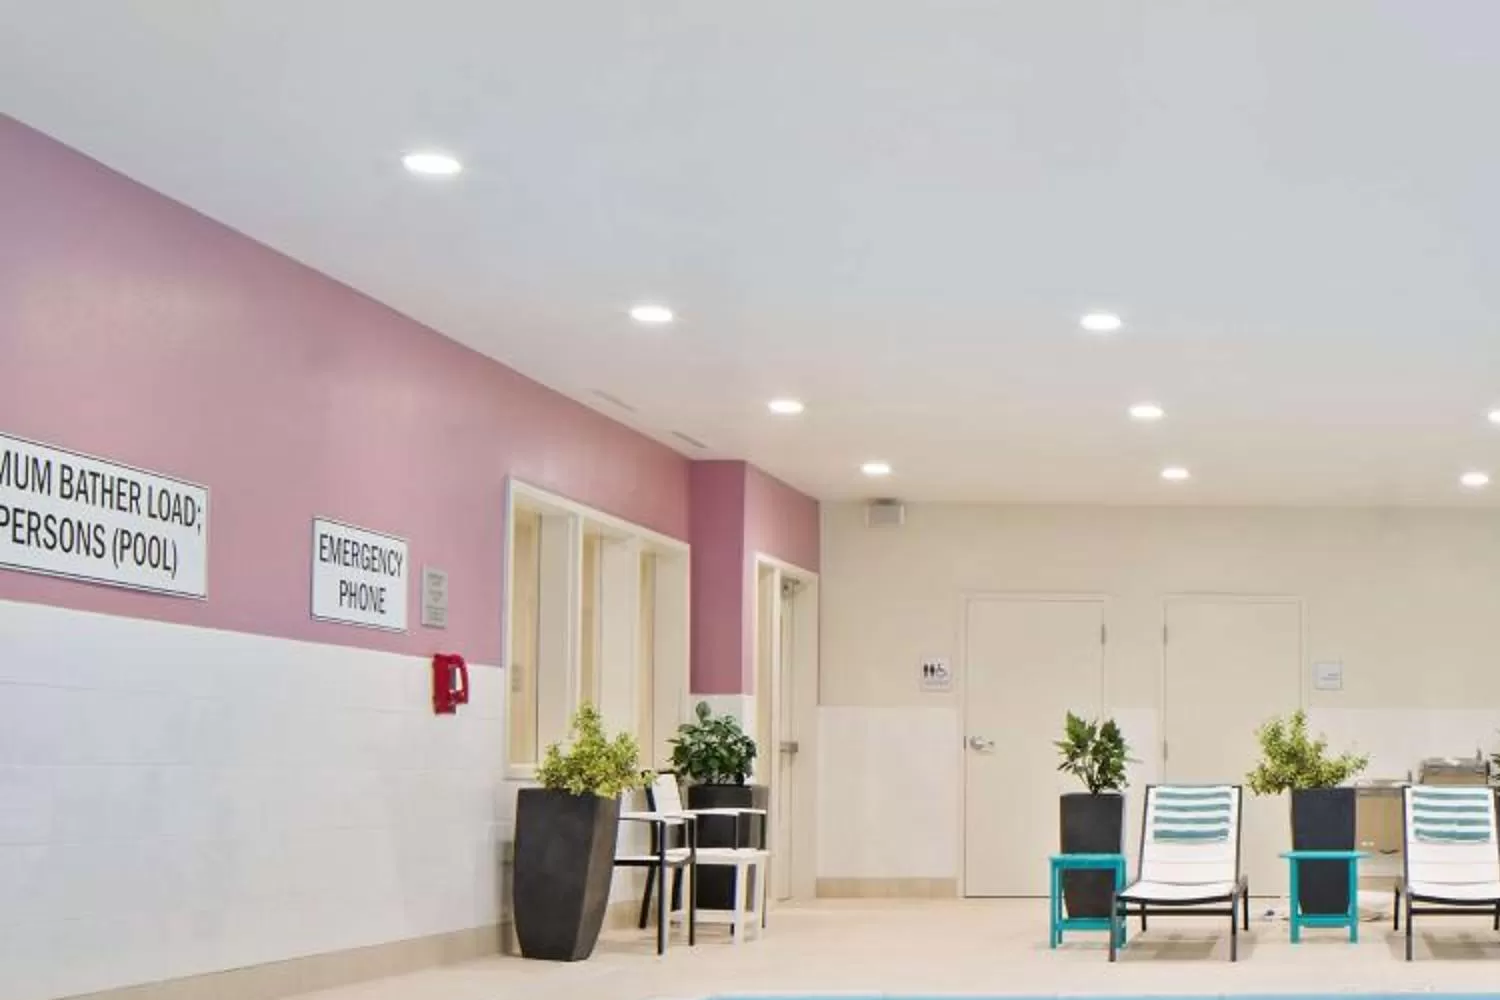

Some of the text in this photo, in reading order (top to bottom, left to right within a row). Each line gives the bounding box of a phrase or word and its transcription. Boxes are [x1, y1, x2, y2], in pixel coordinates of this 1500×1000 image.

[59, 463, 141, 515] BATHER
[0, 504, 177, 580] PERSONS (POOL)
[319, 533, 403, 577] EMERGENCY
[339, 579, 387, 615] PHONE
